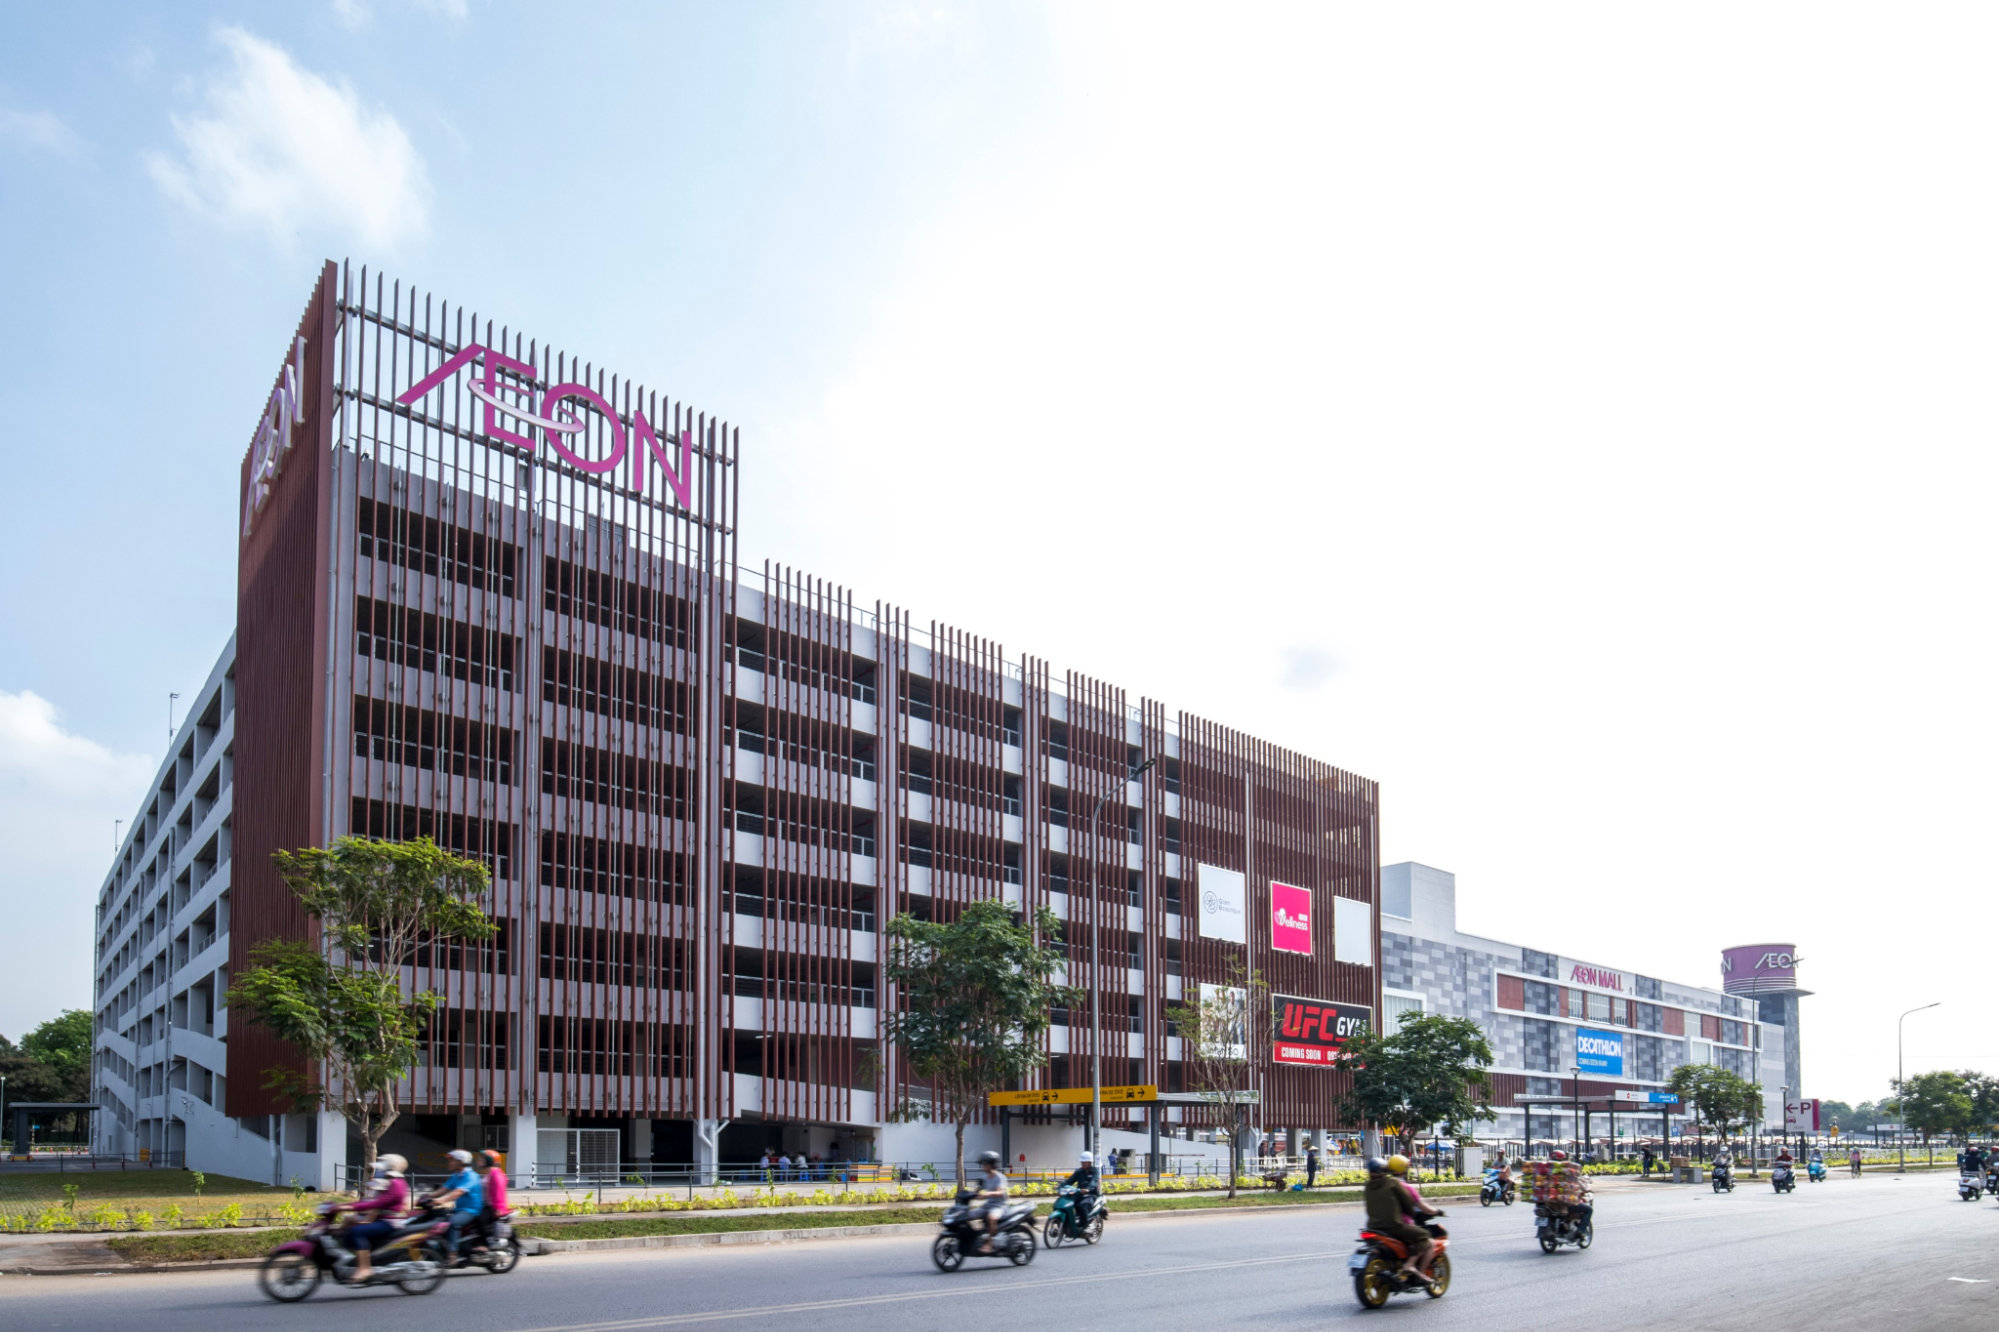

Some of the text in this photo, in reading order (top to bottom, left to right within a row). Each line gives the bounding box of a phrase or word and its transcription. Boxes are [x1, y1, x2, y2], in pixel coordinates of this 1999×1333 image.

[1598, 969, 1624, 991] MALL
[1282, 1003, 1337, 1041] UFC
[1281, 1046, 1304, 1059] COMING
[1305, 1049, 1321, 1061] SOON
[1577, 1036, 1621, 1057] DECATHLON
[1800, 1101, 1811, 1115] P
